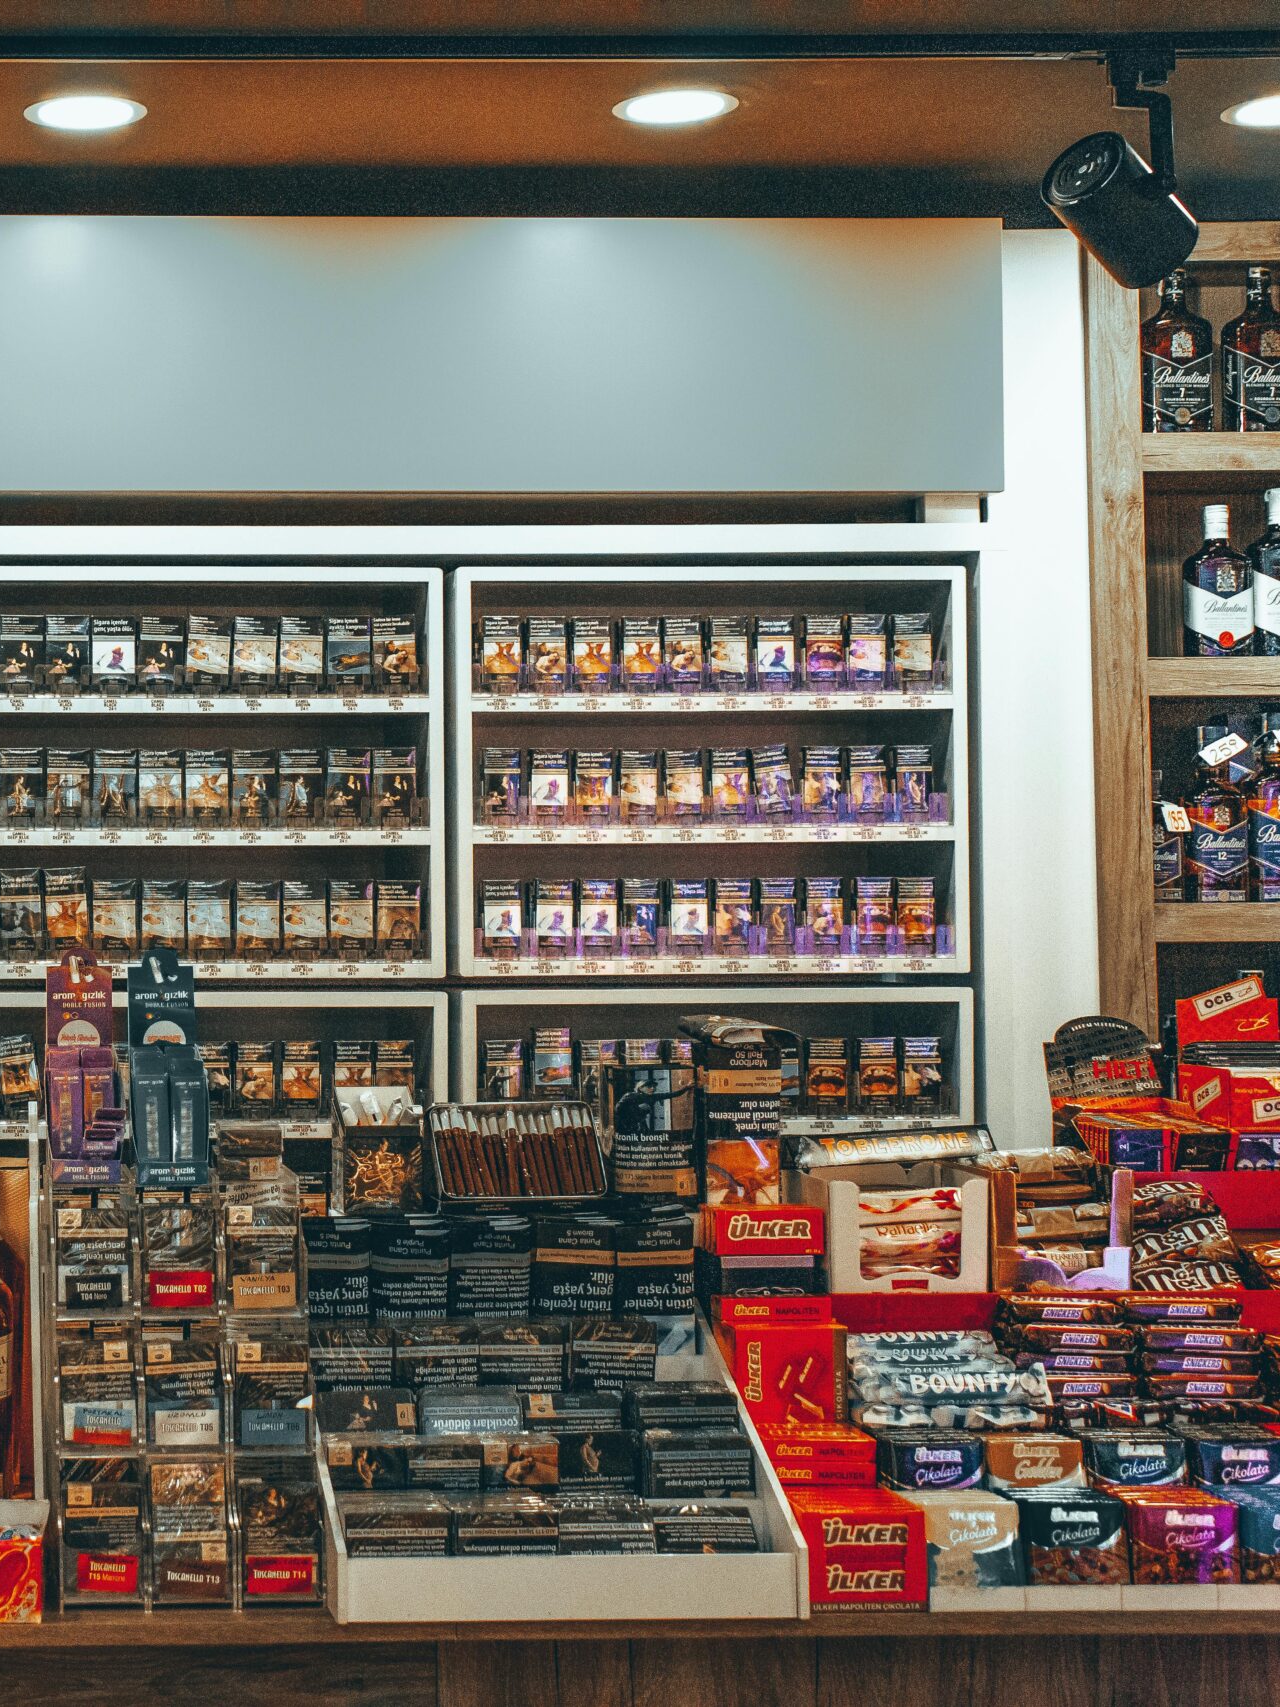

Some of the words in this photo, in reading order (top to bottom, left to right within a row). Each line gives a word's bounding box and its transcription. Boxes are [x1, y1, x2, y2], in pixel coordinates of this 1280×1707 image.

[1204, 992, 1234, 1010] OCB
[730, 1059, 768, 1067] Marlboro
[1136, 1081, 1162, 1092] gold
[1196, 1087, 1210, 1103] OCB
[640, 1133, 669, 1143] bronşit
[821, 1131, 971, 1159] TOBLERONE
[728, 1214, 811, 1241] ÜLKER
[734, 1304, 769, 1315] ÜLKER
[1043, 1308, 1081, 1318] SNICKERS
[1169, 1305, 1206, 1315] SNICKERS
[1062, 1333, 1098, 1344] SNICKERS
[1186, 1335, 1223, 1345] SNICKERS
[1056, 1356, 1092, 1367] SNICKERS
[1183, 1358, 1221, 1369] SNICKERS
[744, 1341, 763, 1403] ÜLKER
[909, 1373, 1017, 1394] BOUNTY
[1064, 1383, 1101, 1394] SNICKERS
[1187, 1383, 1224, 1393] SNICKERS
[776, 1443, 813, 1456] ÜLKER
[914, 1446, 963, 1462] ÜLKER
[915, 1463, 963, 1486] Çikolata
[1120, 1458, 1167, 1479] Çikolata
[1221, 1462, 1270, 1484] Çikolata
[822, 1517, 908, 1547] ÜLKER
[949, 1524, 998, 1545] Çikolata
[1051, 1524, 1100, 1546] Çikolata
[1165, 1527, 1215, 1546] Çikolata
